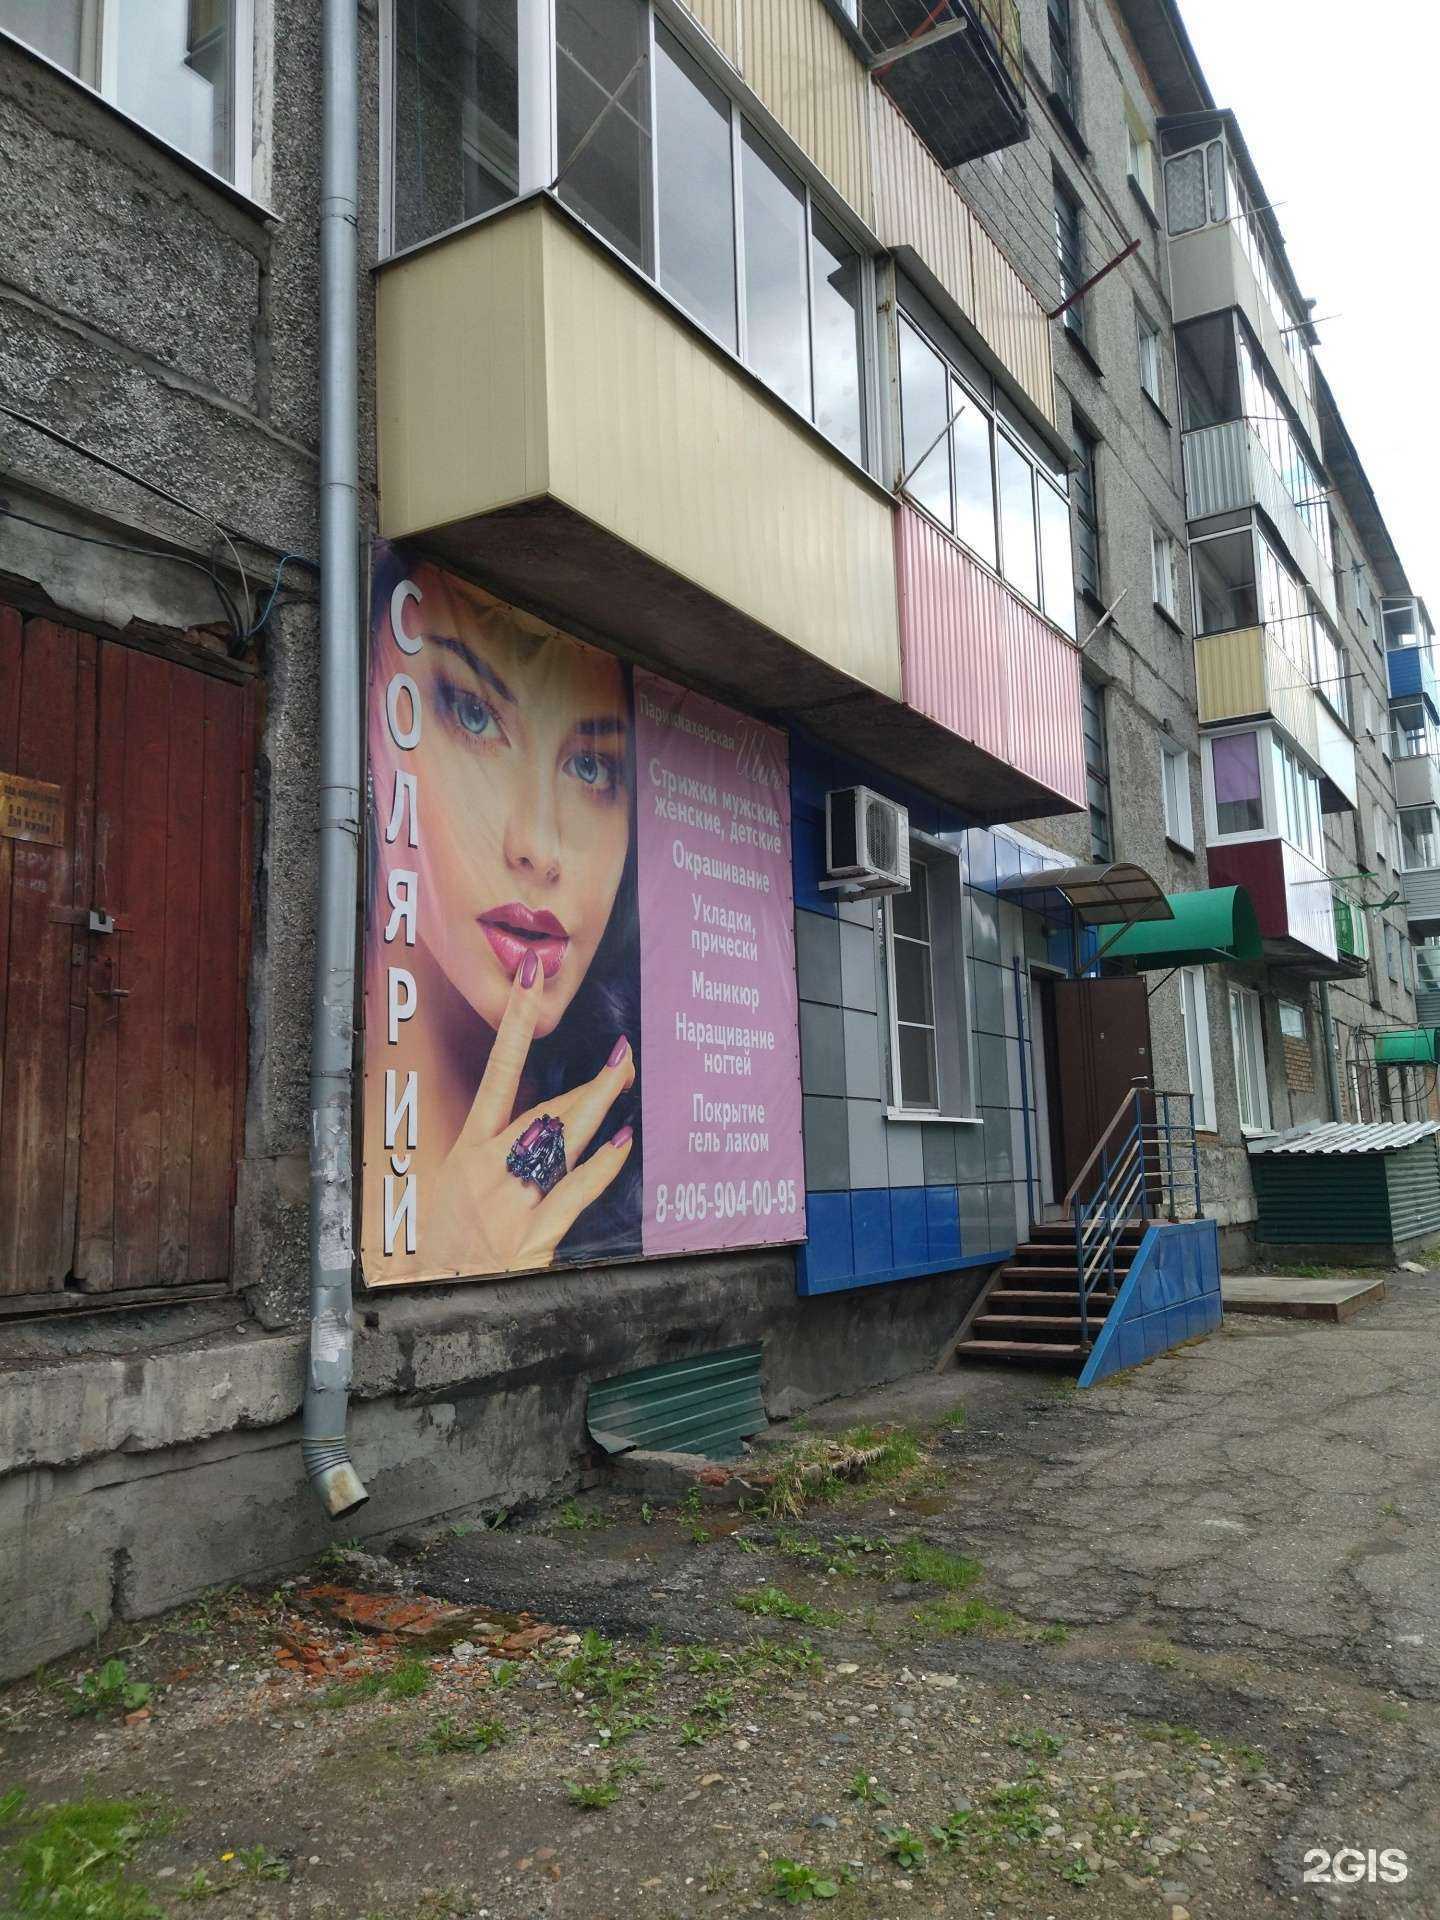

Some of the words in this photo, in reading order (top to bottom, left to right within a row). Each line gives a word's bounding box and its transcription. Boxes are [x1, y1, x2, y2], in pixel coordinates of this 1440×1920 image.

[649, 758, 717, 807] Стрижки
[722, 794, 783, 830] мужские,
[654, 796, 725, 842] женские,
[730, 821, 782, 854] детские
[672, 840, 770, 893] Окрашивание
[384, 579, 423, 1255] СОЛЯРИЙ
[692, 893, 756, 939] Укладки,
[692, 928, 758, 961] прически
[691, 970, 759, 1014] Маникюр
[675, 1012, 775, 1050] Наращивание
[704, 1051, 751, 1075] ногтей
[693, 1094, 765, 1130] Покрытие
[688, 1132, 720, 1152] гель
[725, 1133, 769, 1152] лаком
[656, 1180, 797, 1223] 8-905-904-00-95
